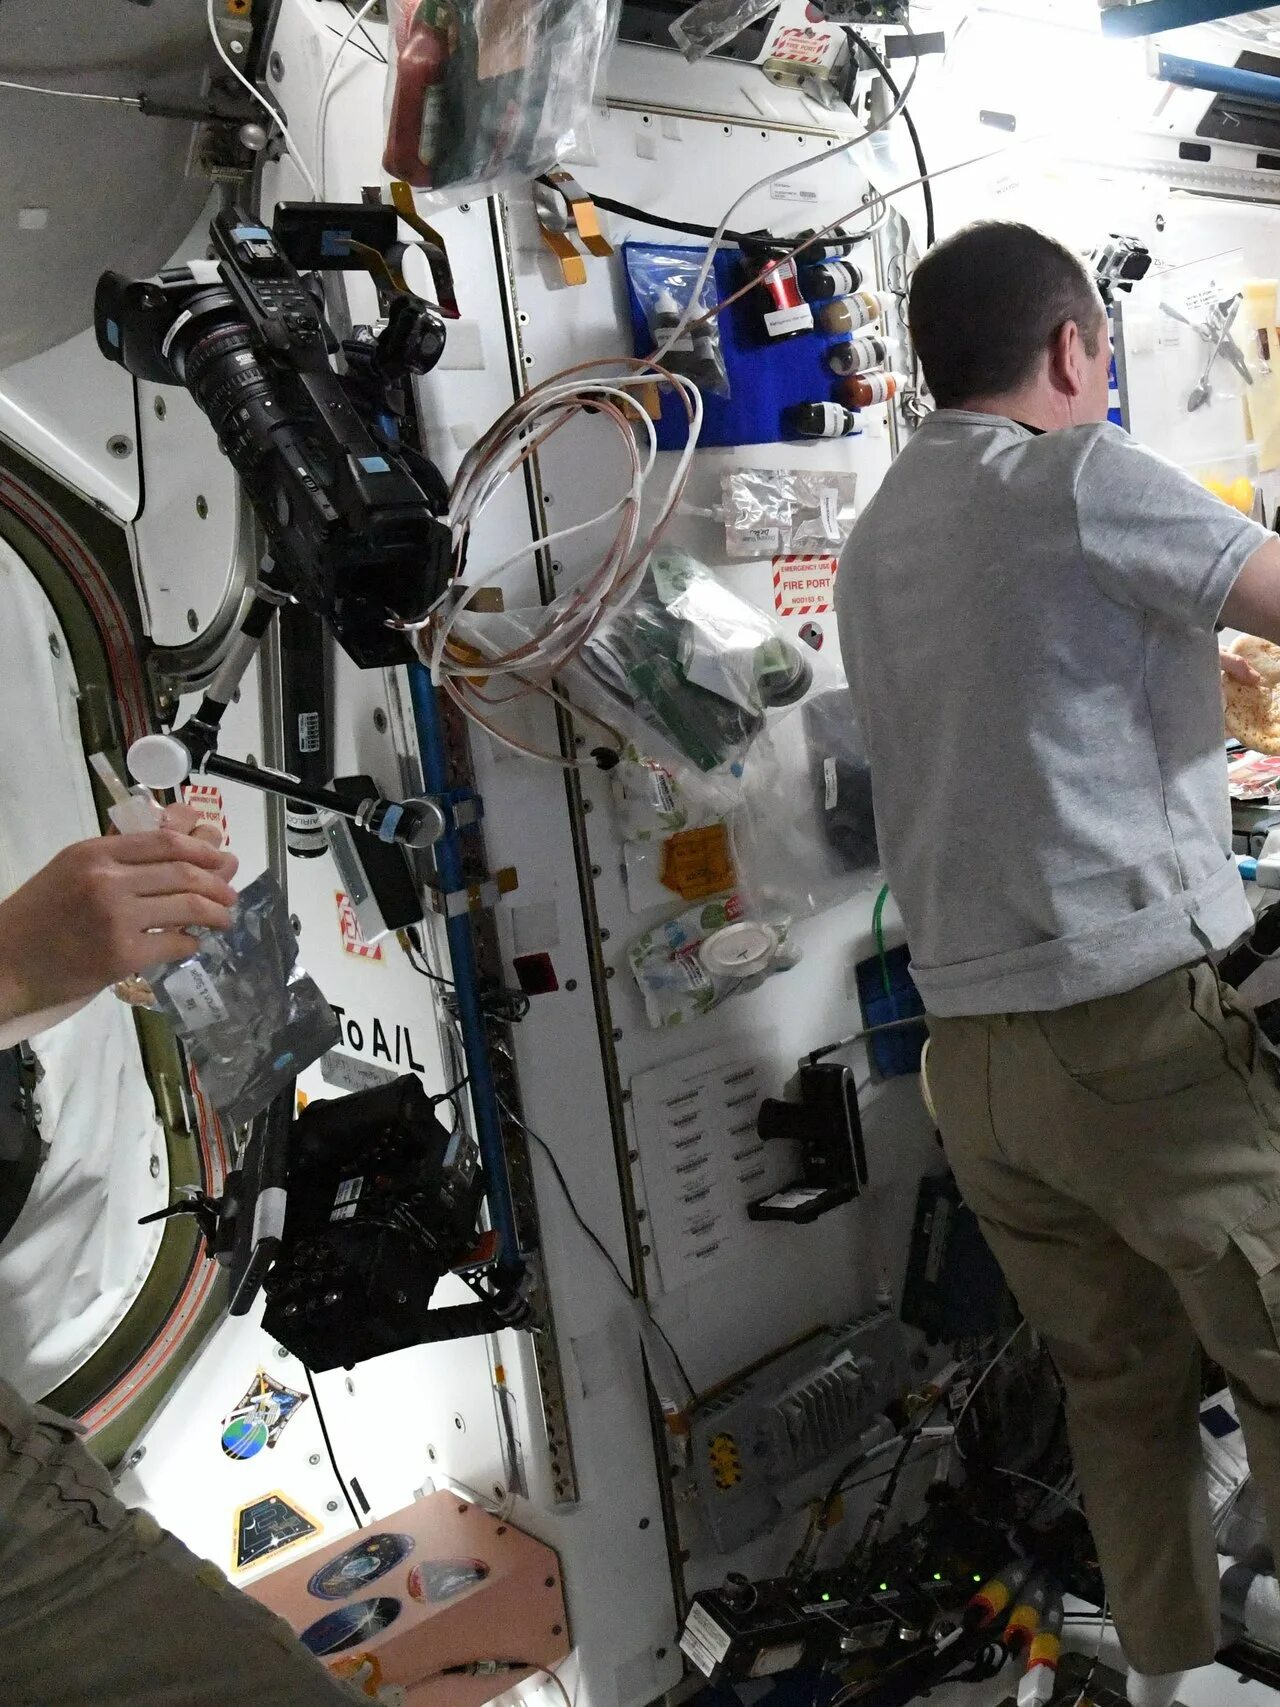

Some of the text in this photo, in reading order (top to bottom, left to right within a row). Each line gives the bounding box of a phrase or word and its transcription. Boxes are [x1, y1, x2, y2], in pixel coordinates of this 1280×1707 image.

[781, 564, 817, 573] EMERGENCY
[783, 578, 831, 590] FIRE PORT
[328, 1003, 364, 1052] To
[373, 1017, 425, 1074] A/L
